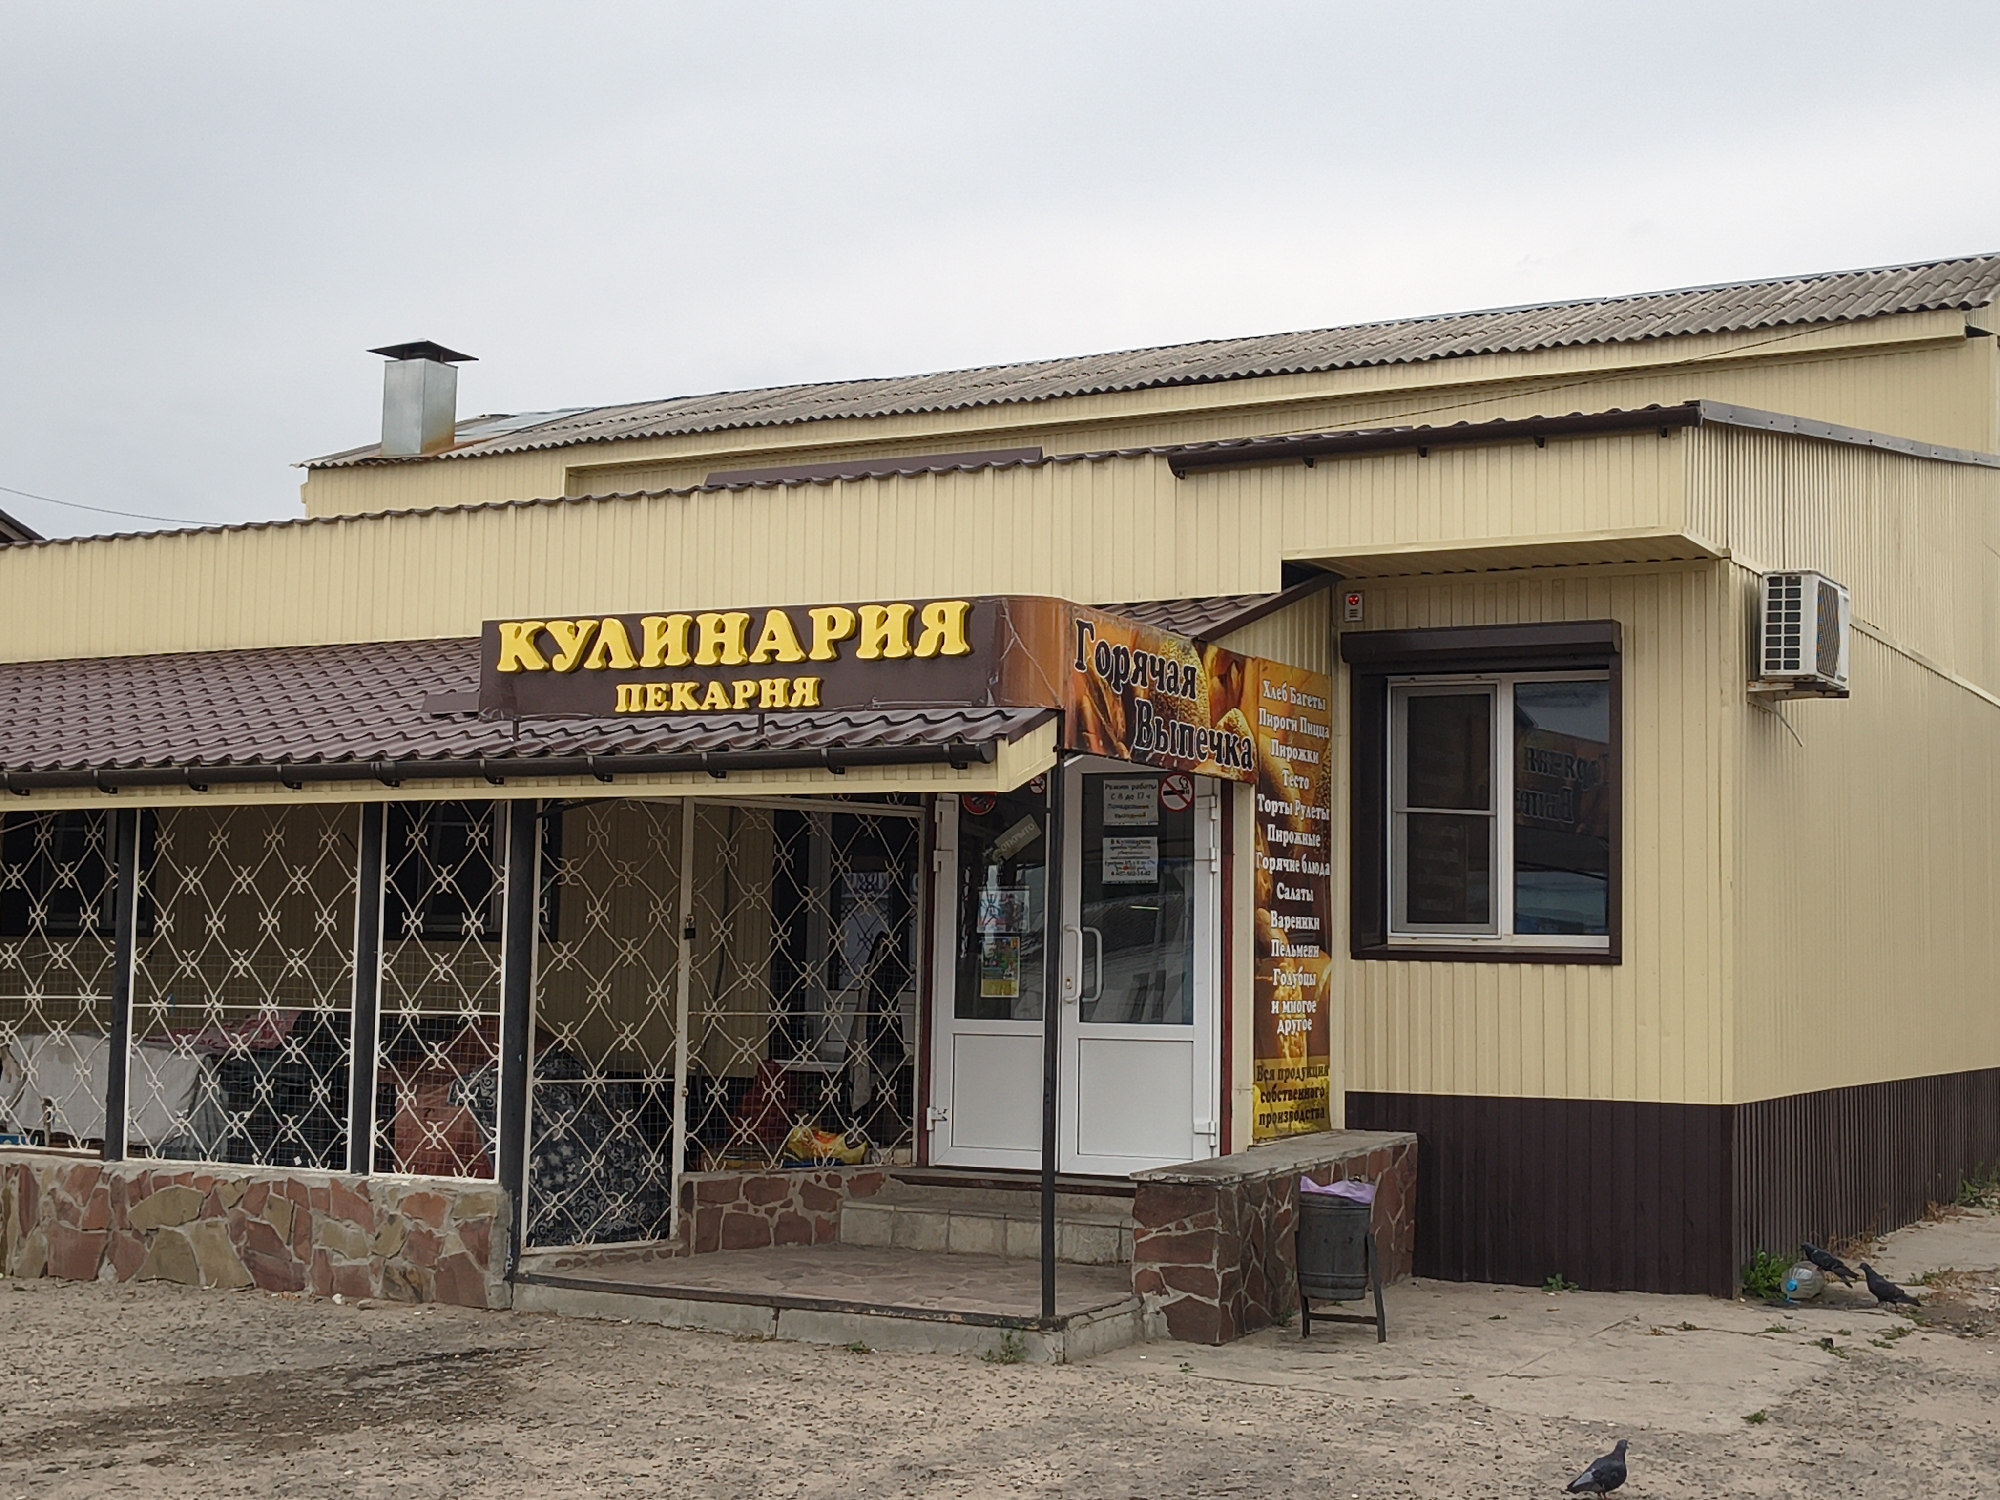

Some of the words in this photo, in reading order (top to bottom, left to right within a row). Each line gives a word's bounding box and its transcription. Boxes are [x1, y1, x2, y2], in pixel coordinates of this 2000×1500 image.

[497, 600, 971, 672] КУЛИНАРИЯ
[1074, 617, 1197, 700] Горячая
[615, 676, 822, 713] ПЕКАРНЯ
[1263, 680, 1288, 702] Хлеб
[1290, 687, 1326, 711] Багеты
[1131, 697, 1253, 771] Выпечка
[1258, 707, 1298, 732] Пироги
[1299, 716, 1330, 740] Пицца
[1271, 739, 1319, 765] Пирожки
[1281, 769, 1310, 790] Тесто
[1257, 793, 1292, 817] Торты
[1294, 799, 1330, 820] Рулеты
[1000, 822, 1035, 852] ОТКРЫТО
[1267, 823, 1321, 847] Пирожные
[1256, 852, 1300, 875] Горячие
[1301, 853, 1331, 876] блюда
[1276, 882, 1314, 902] Салаты
[1270, 910, 1320, 932] Вареники
[1270, 939, 1320, 958] Пельмени
[1272, 965, 1317, 989] Голубцы
[1270, 1000, 1280, 1014] и
[1281, 999, 1317, 1014] многое
[1277, 1018, 1313, 1036] другое
[1256, 1064, 1275, 1082] Вся
[1277, 1064, 1329, 1083] продукция
[1260, 1083, 1325, 1103] собственного
[1258, 1107, 1325, 1128] производства
